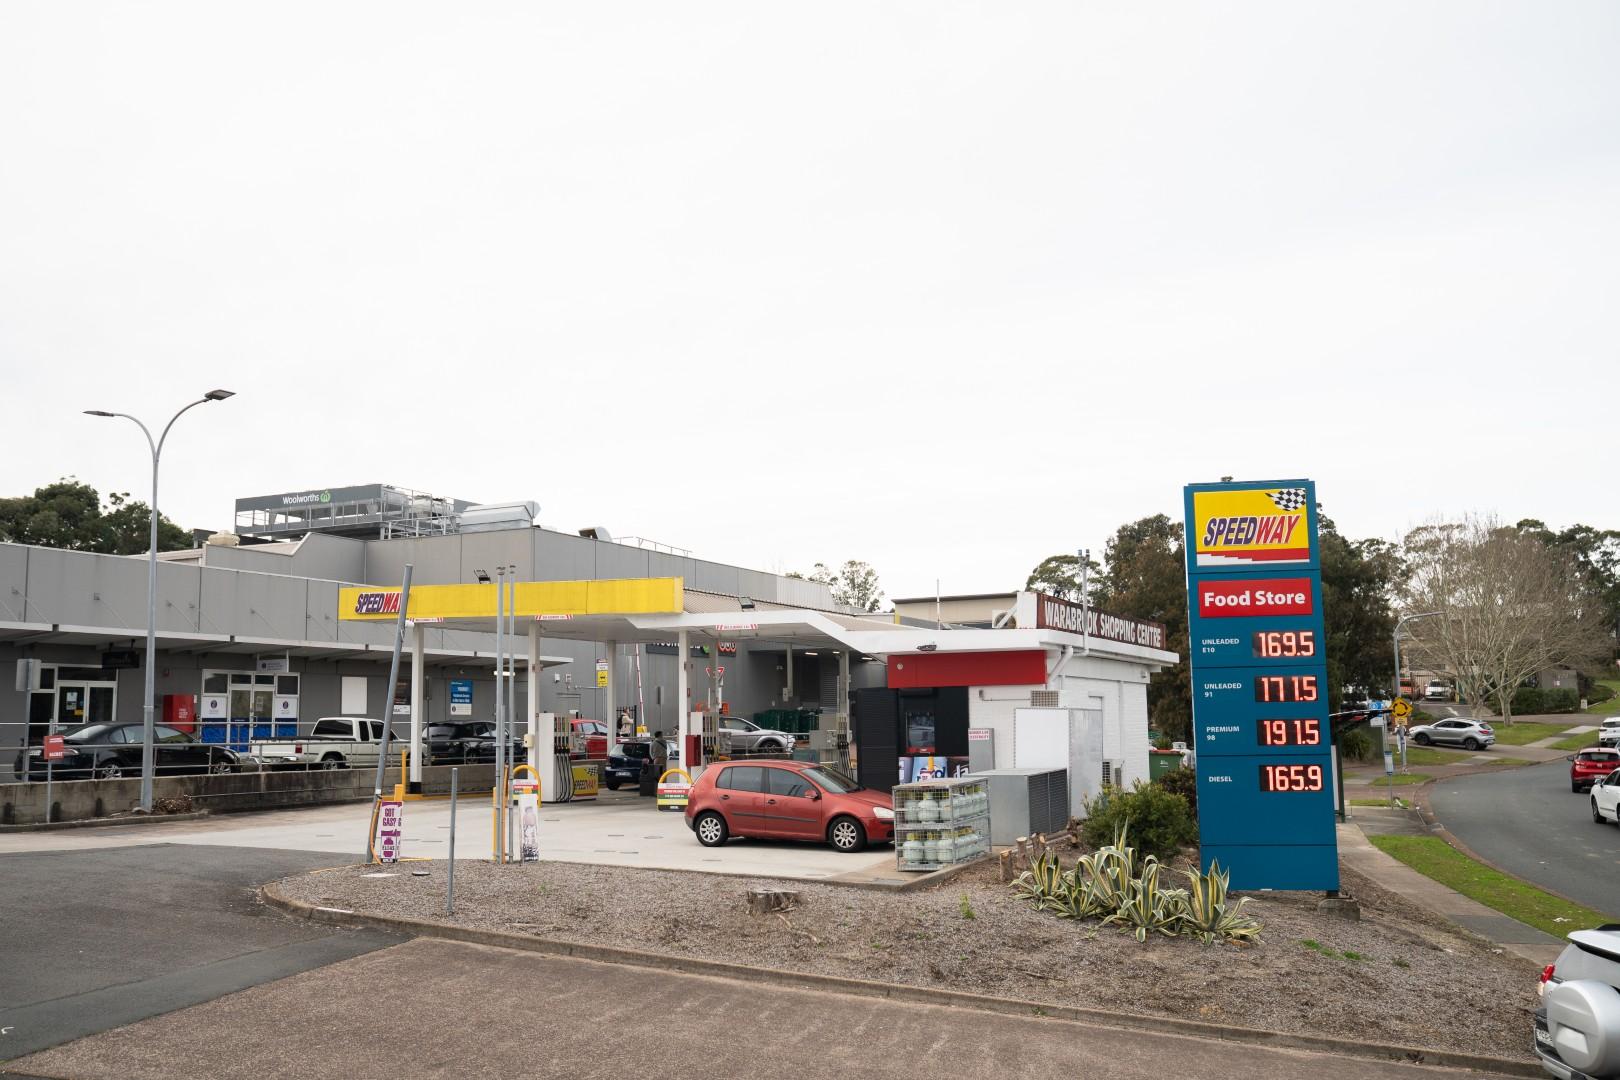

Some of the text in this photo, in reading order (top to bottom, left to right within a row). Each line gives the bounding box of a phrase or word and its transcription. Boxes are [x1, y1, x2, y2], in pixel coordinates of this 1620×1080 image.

[282, 493, 320, 504] Woolworths
[1203, 515, 1301, 547] SPEEDWAY
[355, 592, 402, 613] SPEEDWA
[1204, 590, 1306, 607] Food Store
[1044, 600, 1161, 648] WARABROK SHOPPING CENTRE
[1259, 631, 1315, 657] 169.5
[1266, 765, 1322, 791] 165.9
[382, 817, 397, 827] GAS?
[384, 808, 395, 818] GOT
